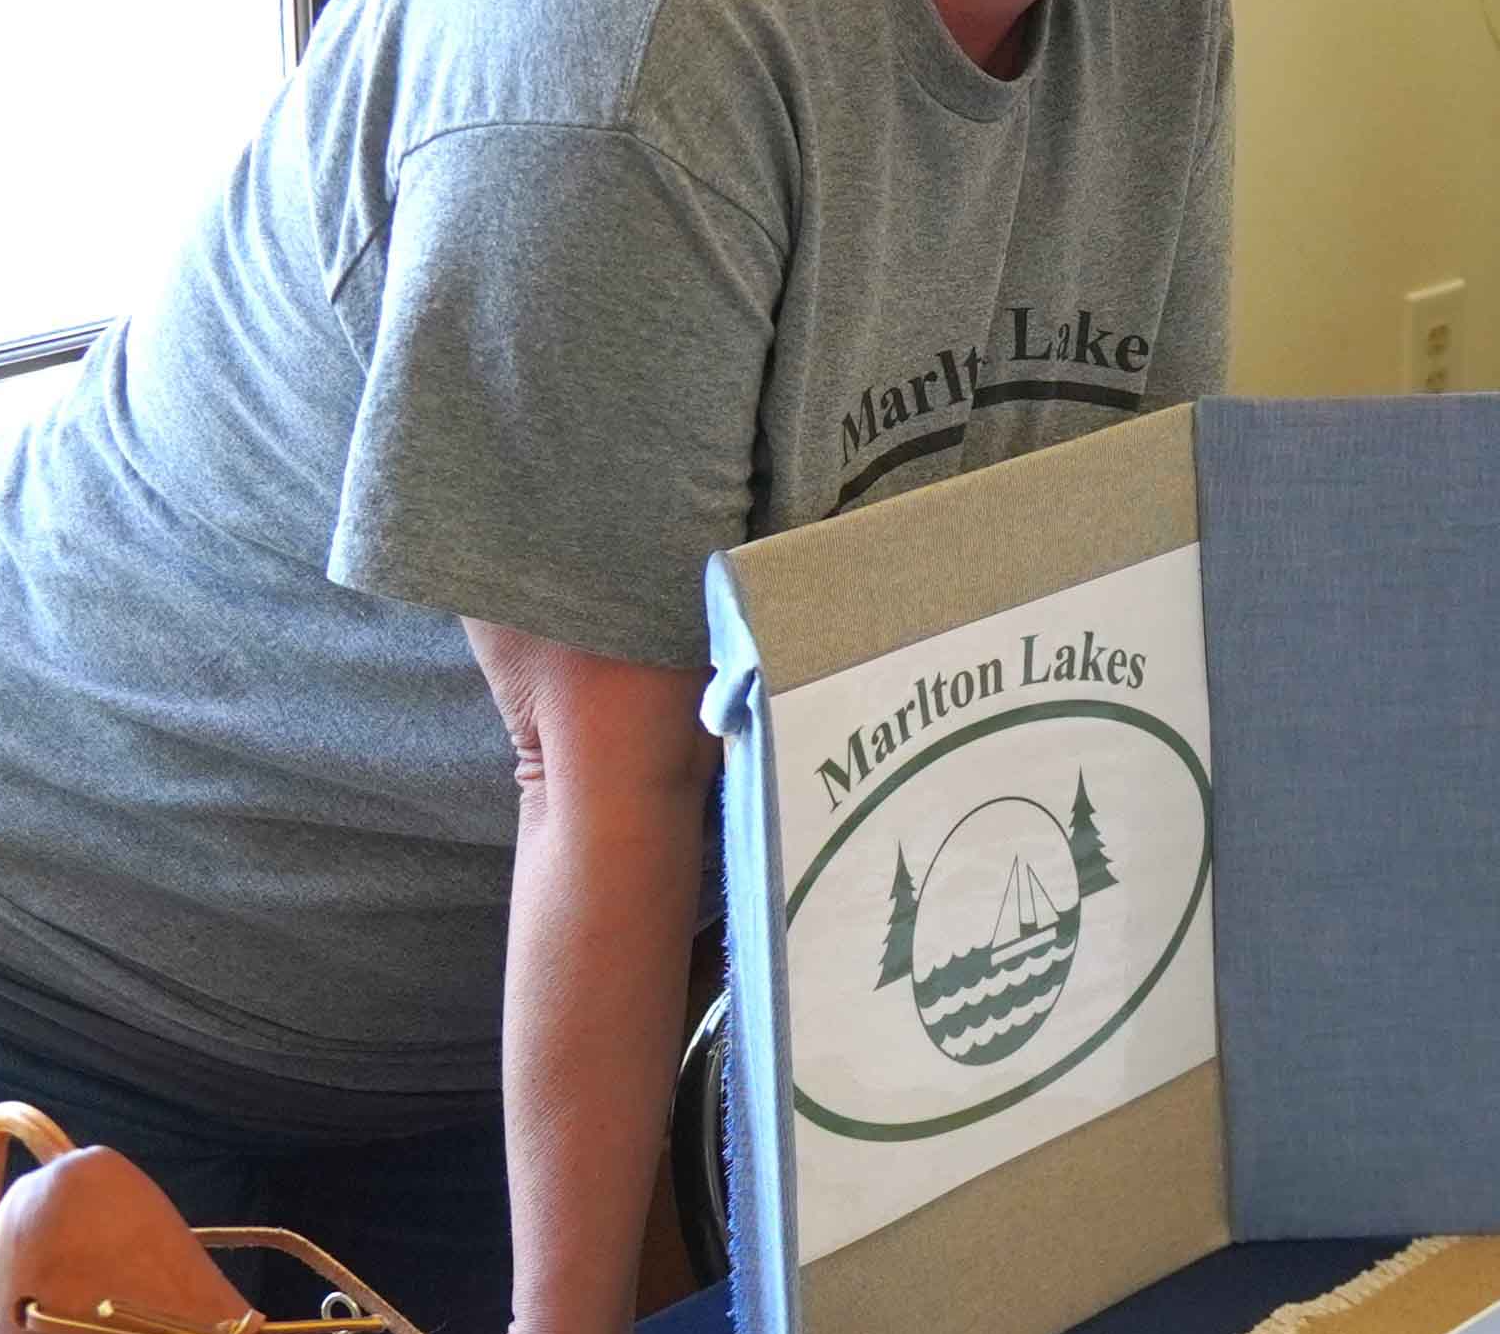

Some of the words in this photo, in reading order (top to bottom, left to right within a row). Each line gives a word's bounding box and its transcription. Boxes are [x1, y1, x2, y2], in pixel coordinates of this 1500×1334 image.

[841, 347, 987, 467] Marlt
[814, 656, 1005, 813] Marlton
[1019, 631, 1147, 690] Lakes
